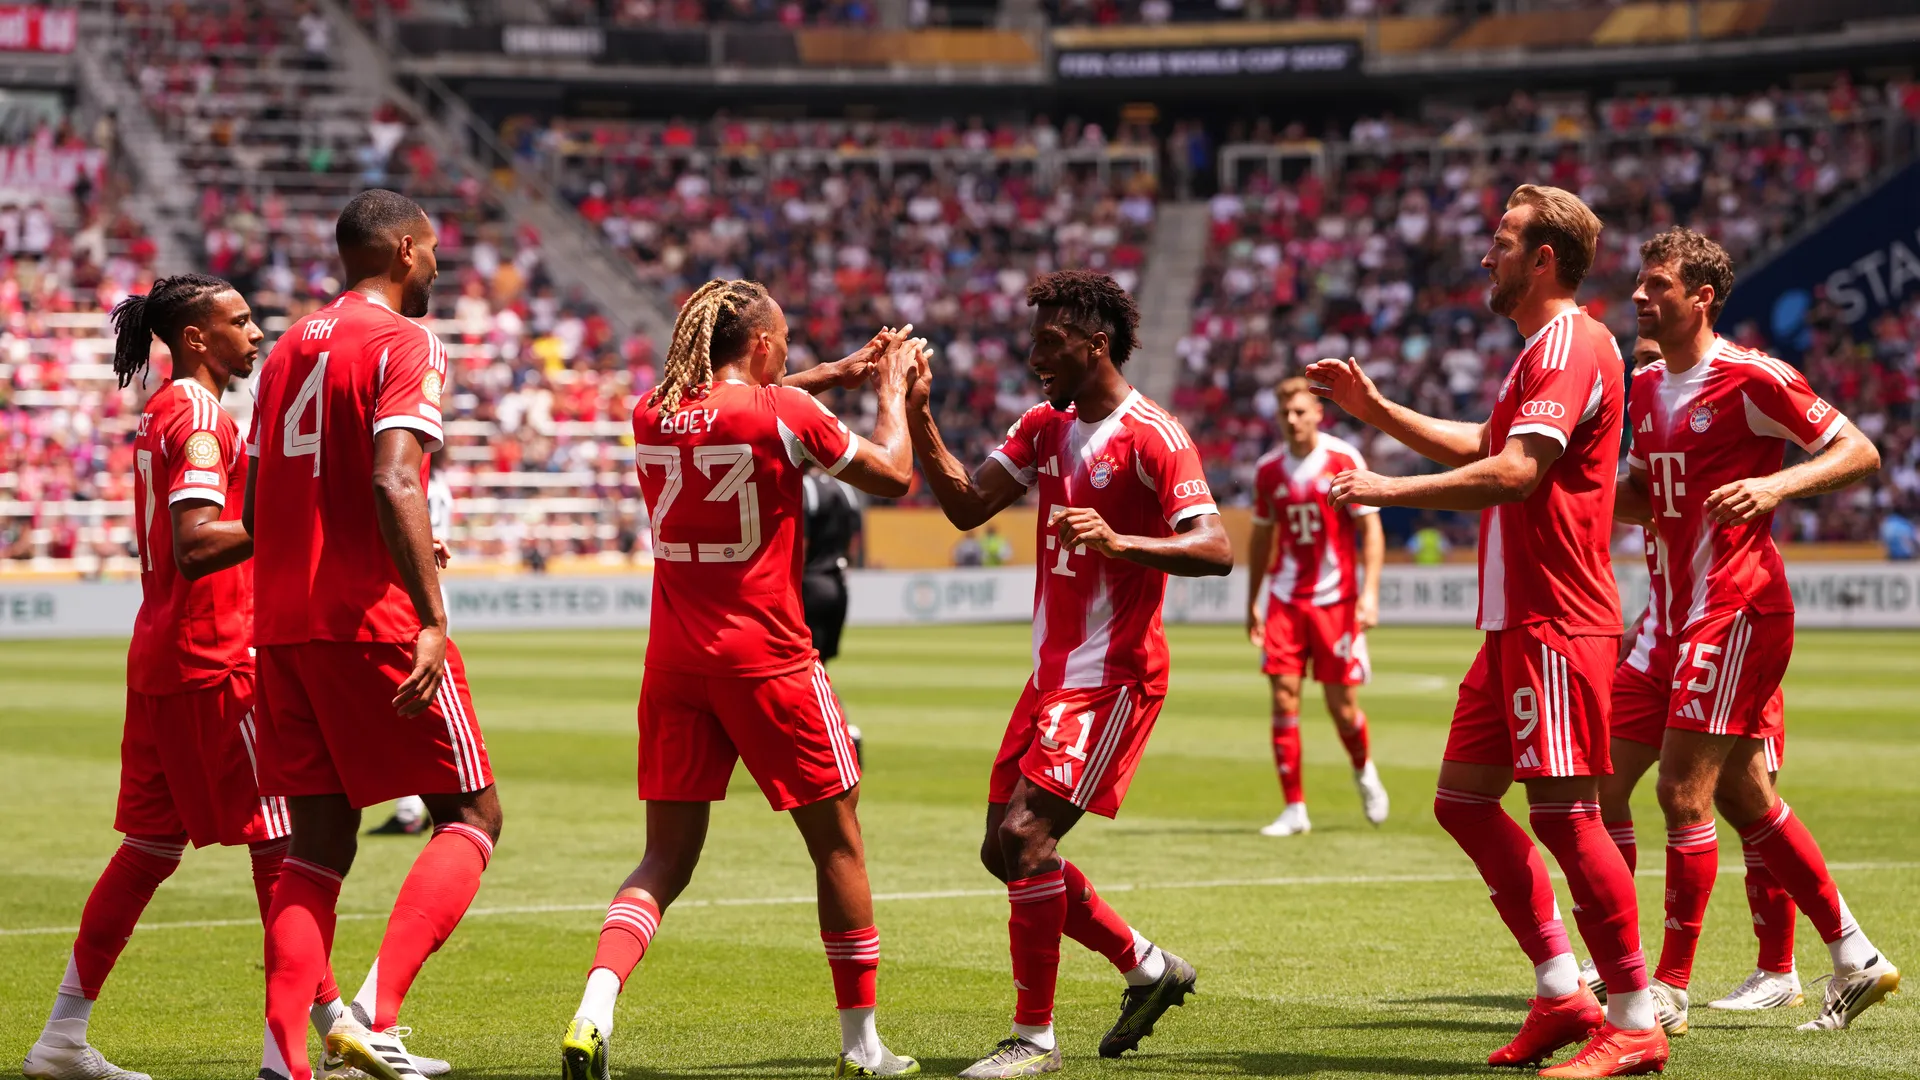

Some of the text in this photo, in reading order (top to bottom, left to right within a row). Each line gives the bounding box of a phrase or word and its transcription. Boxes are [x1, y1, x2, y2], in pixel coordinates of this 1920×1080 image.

[1825, 238, 1920, 324] STA
[302, 318, 339, 341] TAH
[283, 351, 330, 478] 4
[660, 408, 719, 434] BOEY
[636, 443, 762, 563] 23
[1649, 453, 1686, 518] T
[1287, 502, 1322, 544] T
[1672, 642, 1721, 693] 25
[1040, 703, 1096, 762] 11
[1513, 687, 1538, 740] 9
